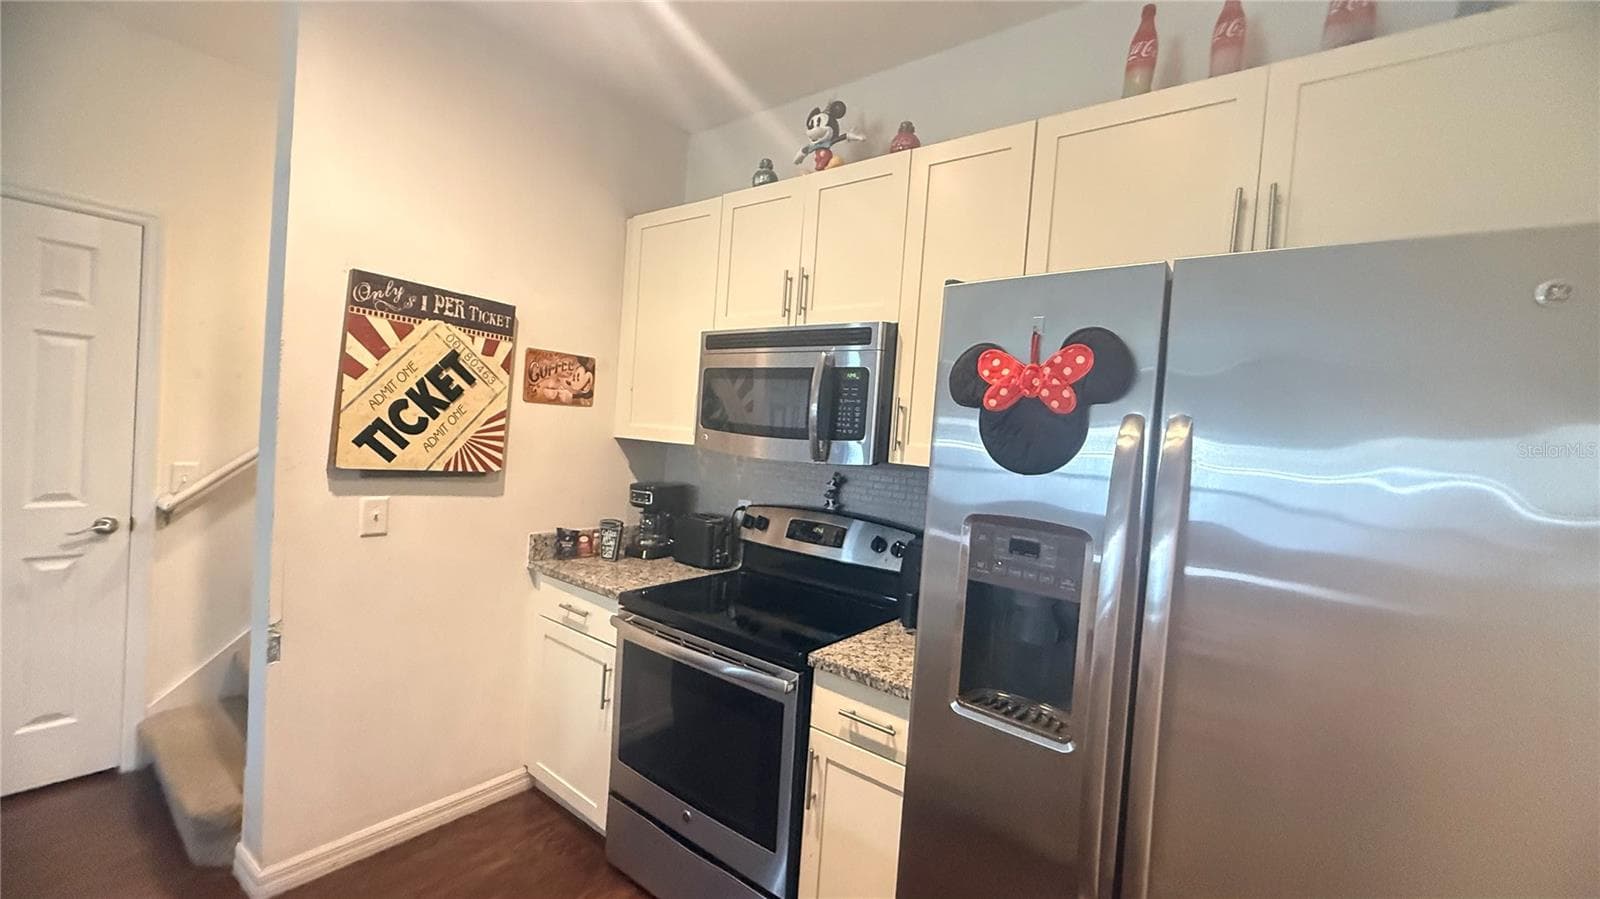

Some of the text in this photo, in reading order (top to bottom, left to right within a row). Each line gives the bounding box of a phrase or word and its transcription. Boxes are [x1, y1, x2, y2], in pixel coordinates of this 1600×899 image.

[353, 280, 403, 303] Only
[433, 294, 465, 320] PER
[468, 305, 512, 329] TICKET
[351, 349, 477, 464] TICKET
[369, 360, 419, 411] ADMIT ONE
[423, 404, 468, 453] ADMIT ONE
